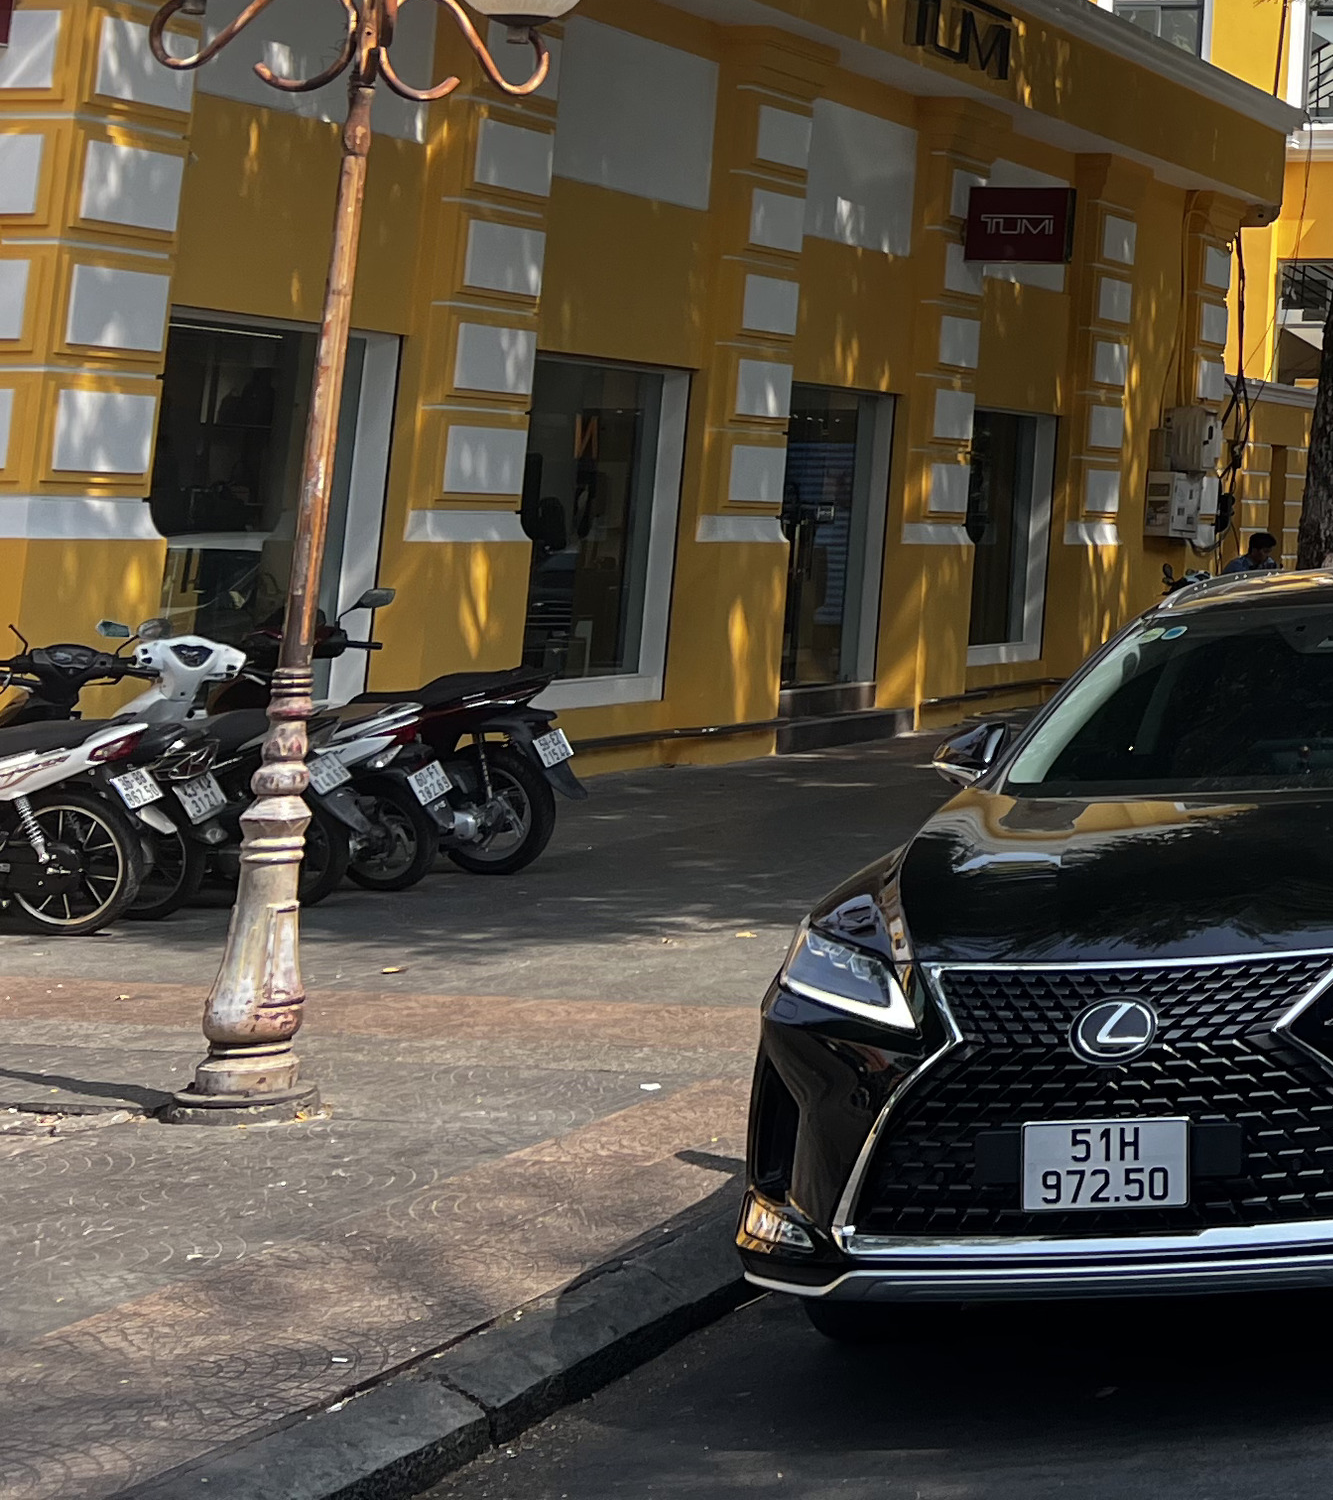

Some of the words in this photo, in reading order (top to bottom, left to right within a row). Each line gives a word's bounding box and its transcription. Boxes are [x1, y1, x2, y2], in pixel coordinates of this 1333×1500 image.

[980, 214, 1054, 235] TUMI
[1071, 1127, 1140, 1162] 51H
[1041, 1167, 1169, 1204] 972.50
